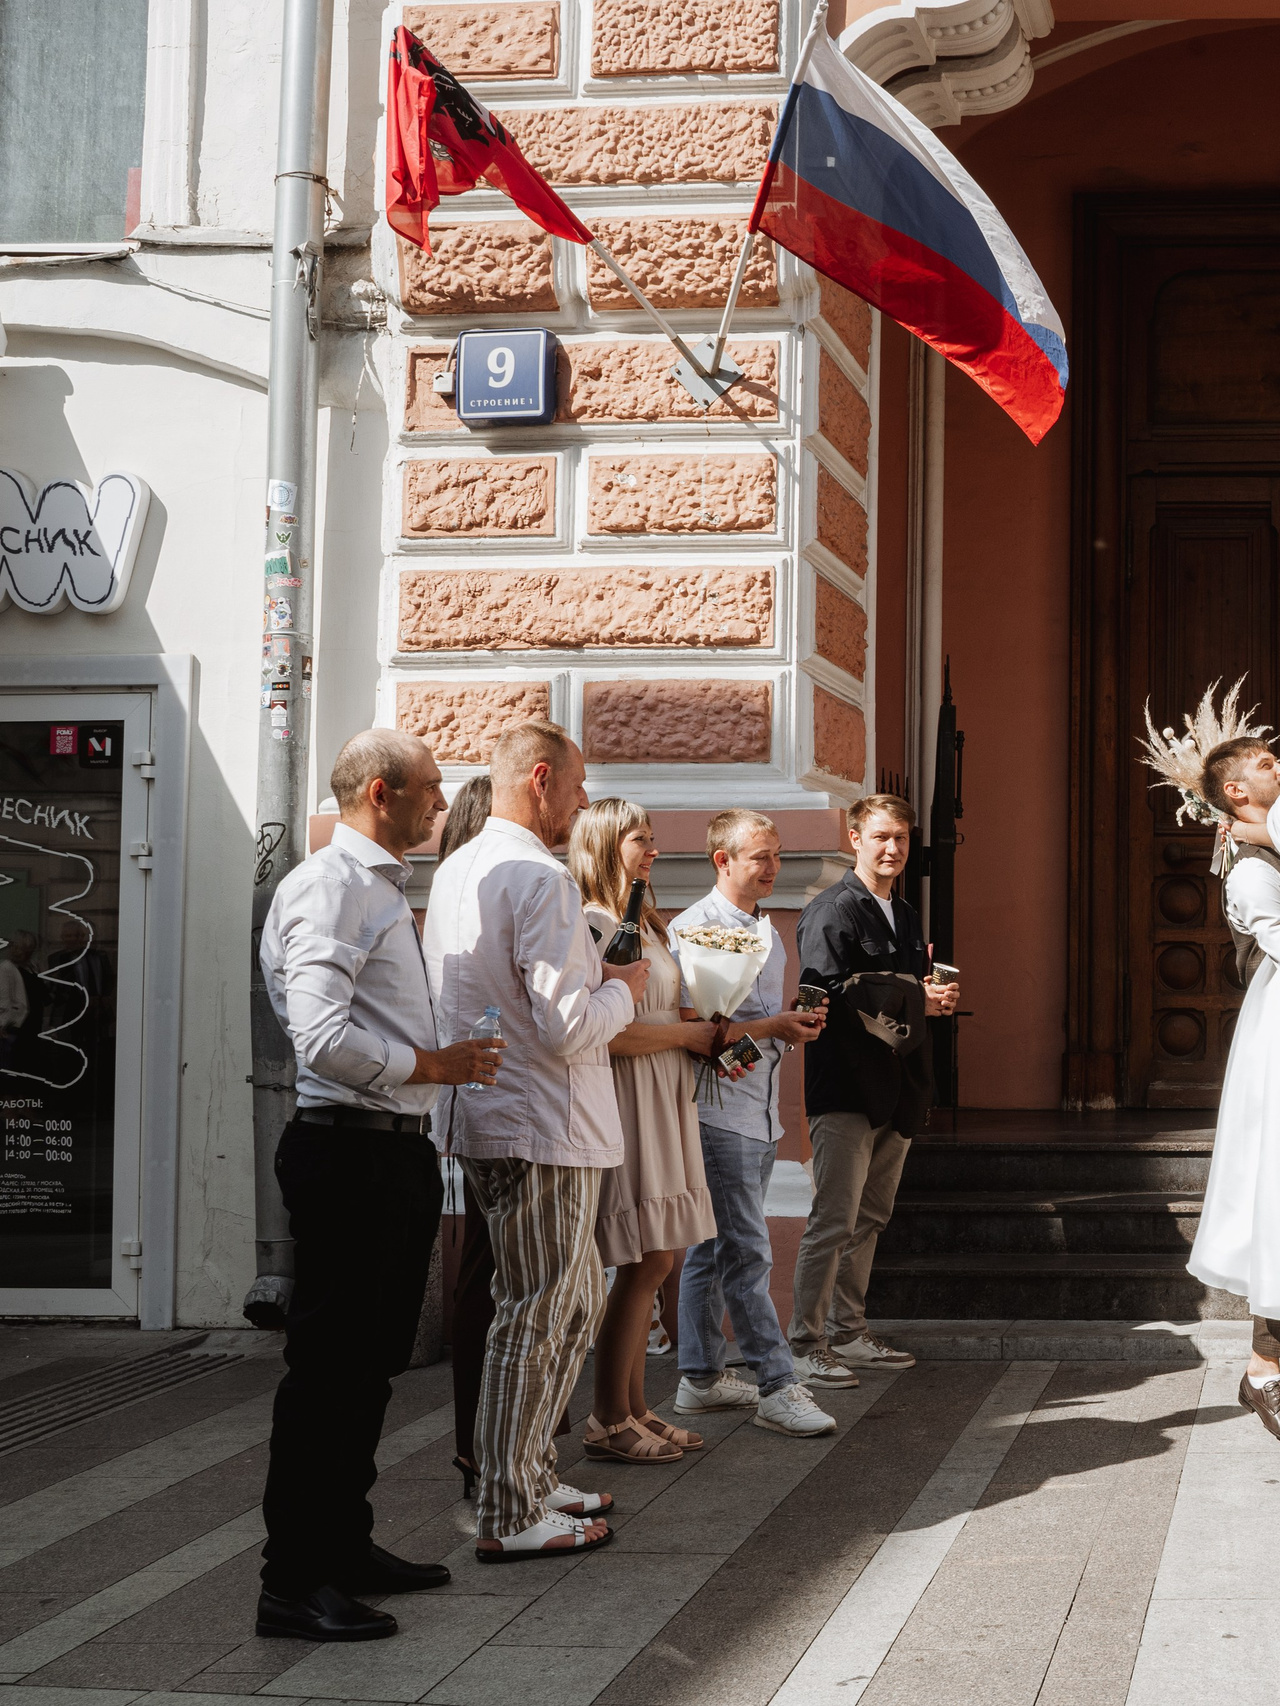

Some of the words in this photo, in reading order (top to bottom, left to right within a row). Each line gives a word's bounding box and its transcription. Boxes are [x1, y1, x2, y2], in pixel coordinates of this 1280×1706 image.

[487, 347, 515, 388] 9
[470, 398, 525, 407] СТРОЕНИЕ
[0, 797, 93, 840] ЕСНИК
[6, 1118, 30, 1130] 14:00
[45, 1119, 72, 1131] 00:00
[5, 1134, 31, 1147] 14:00
[45, 1136, 73, 1147] 06:00
[5, 1149, 31, 1161] 14:00
[45, 1149, 73, 1162] 00:00
